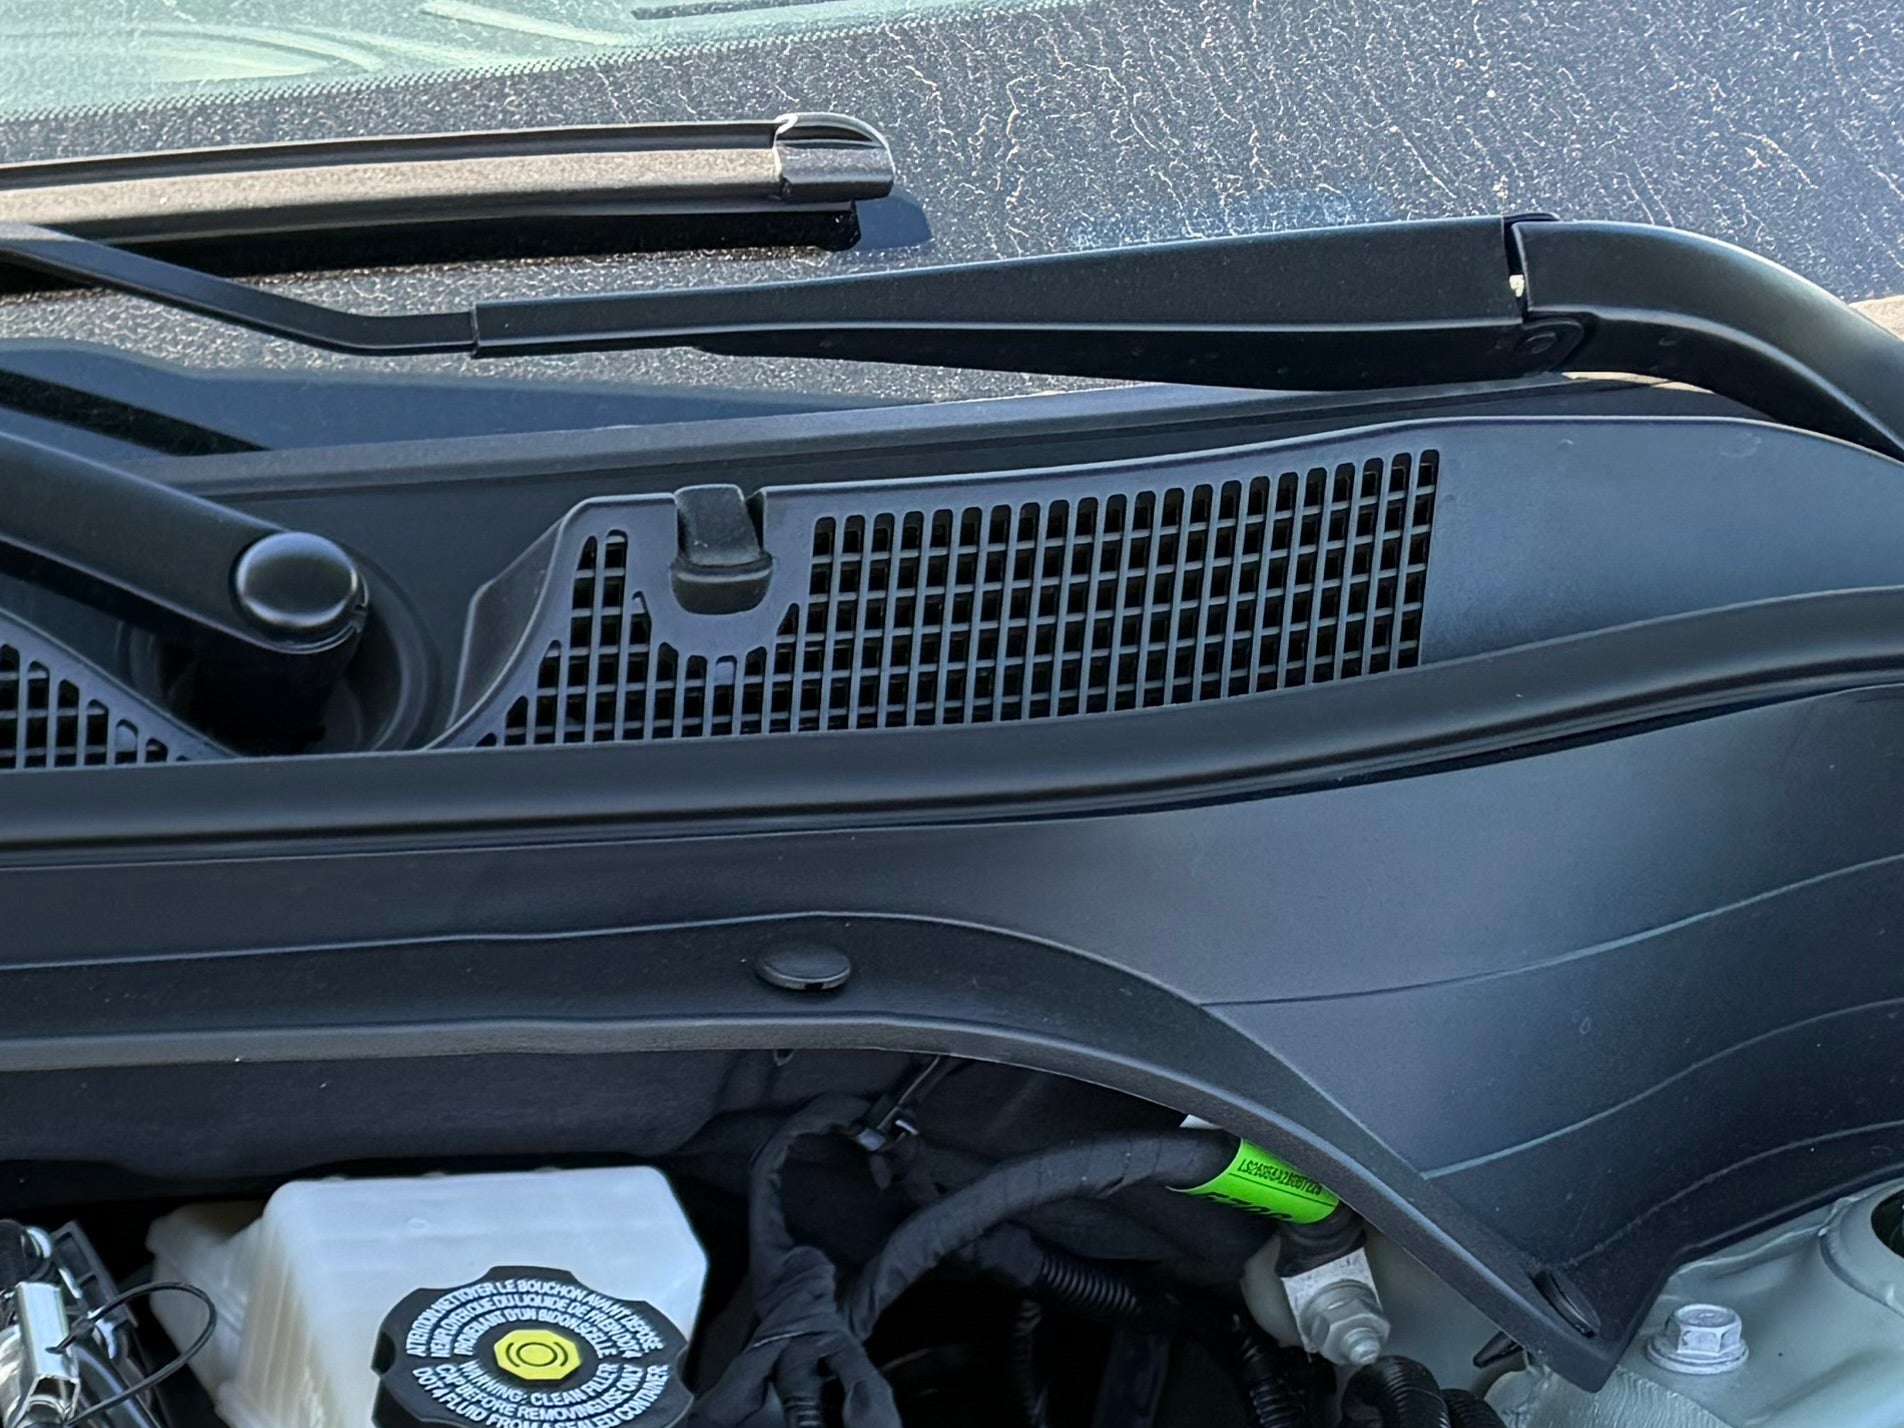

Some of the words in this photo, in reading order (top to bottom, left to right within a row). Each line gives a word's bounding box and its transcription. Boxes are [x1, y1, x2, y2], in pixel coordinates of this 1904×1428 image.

[496, 1280, 516, 1293] LE
[517, 1280, 588, 1301] BOUCHON
[585, 1293, 631, 1319] AVANT
[567, 1302, 590, 1317] DE
[435, 1364, 466, 1386] CAP
[455, 1384, 517, 1415] BEFORE
[616, 1364, 643, 1391] ONLY
[438, 1393, 489, 1421] FLUID
[615, 1364, 672, 1420] CONTAINER
[531, 1389, 587, 1406] CLEAN
[581, 1363, 619, 1396] FILLER
